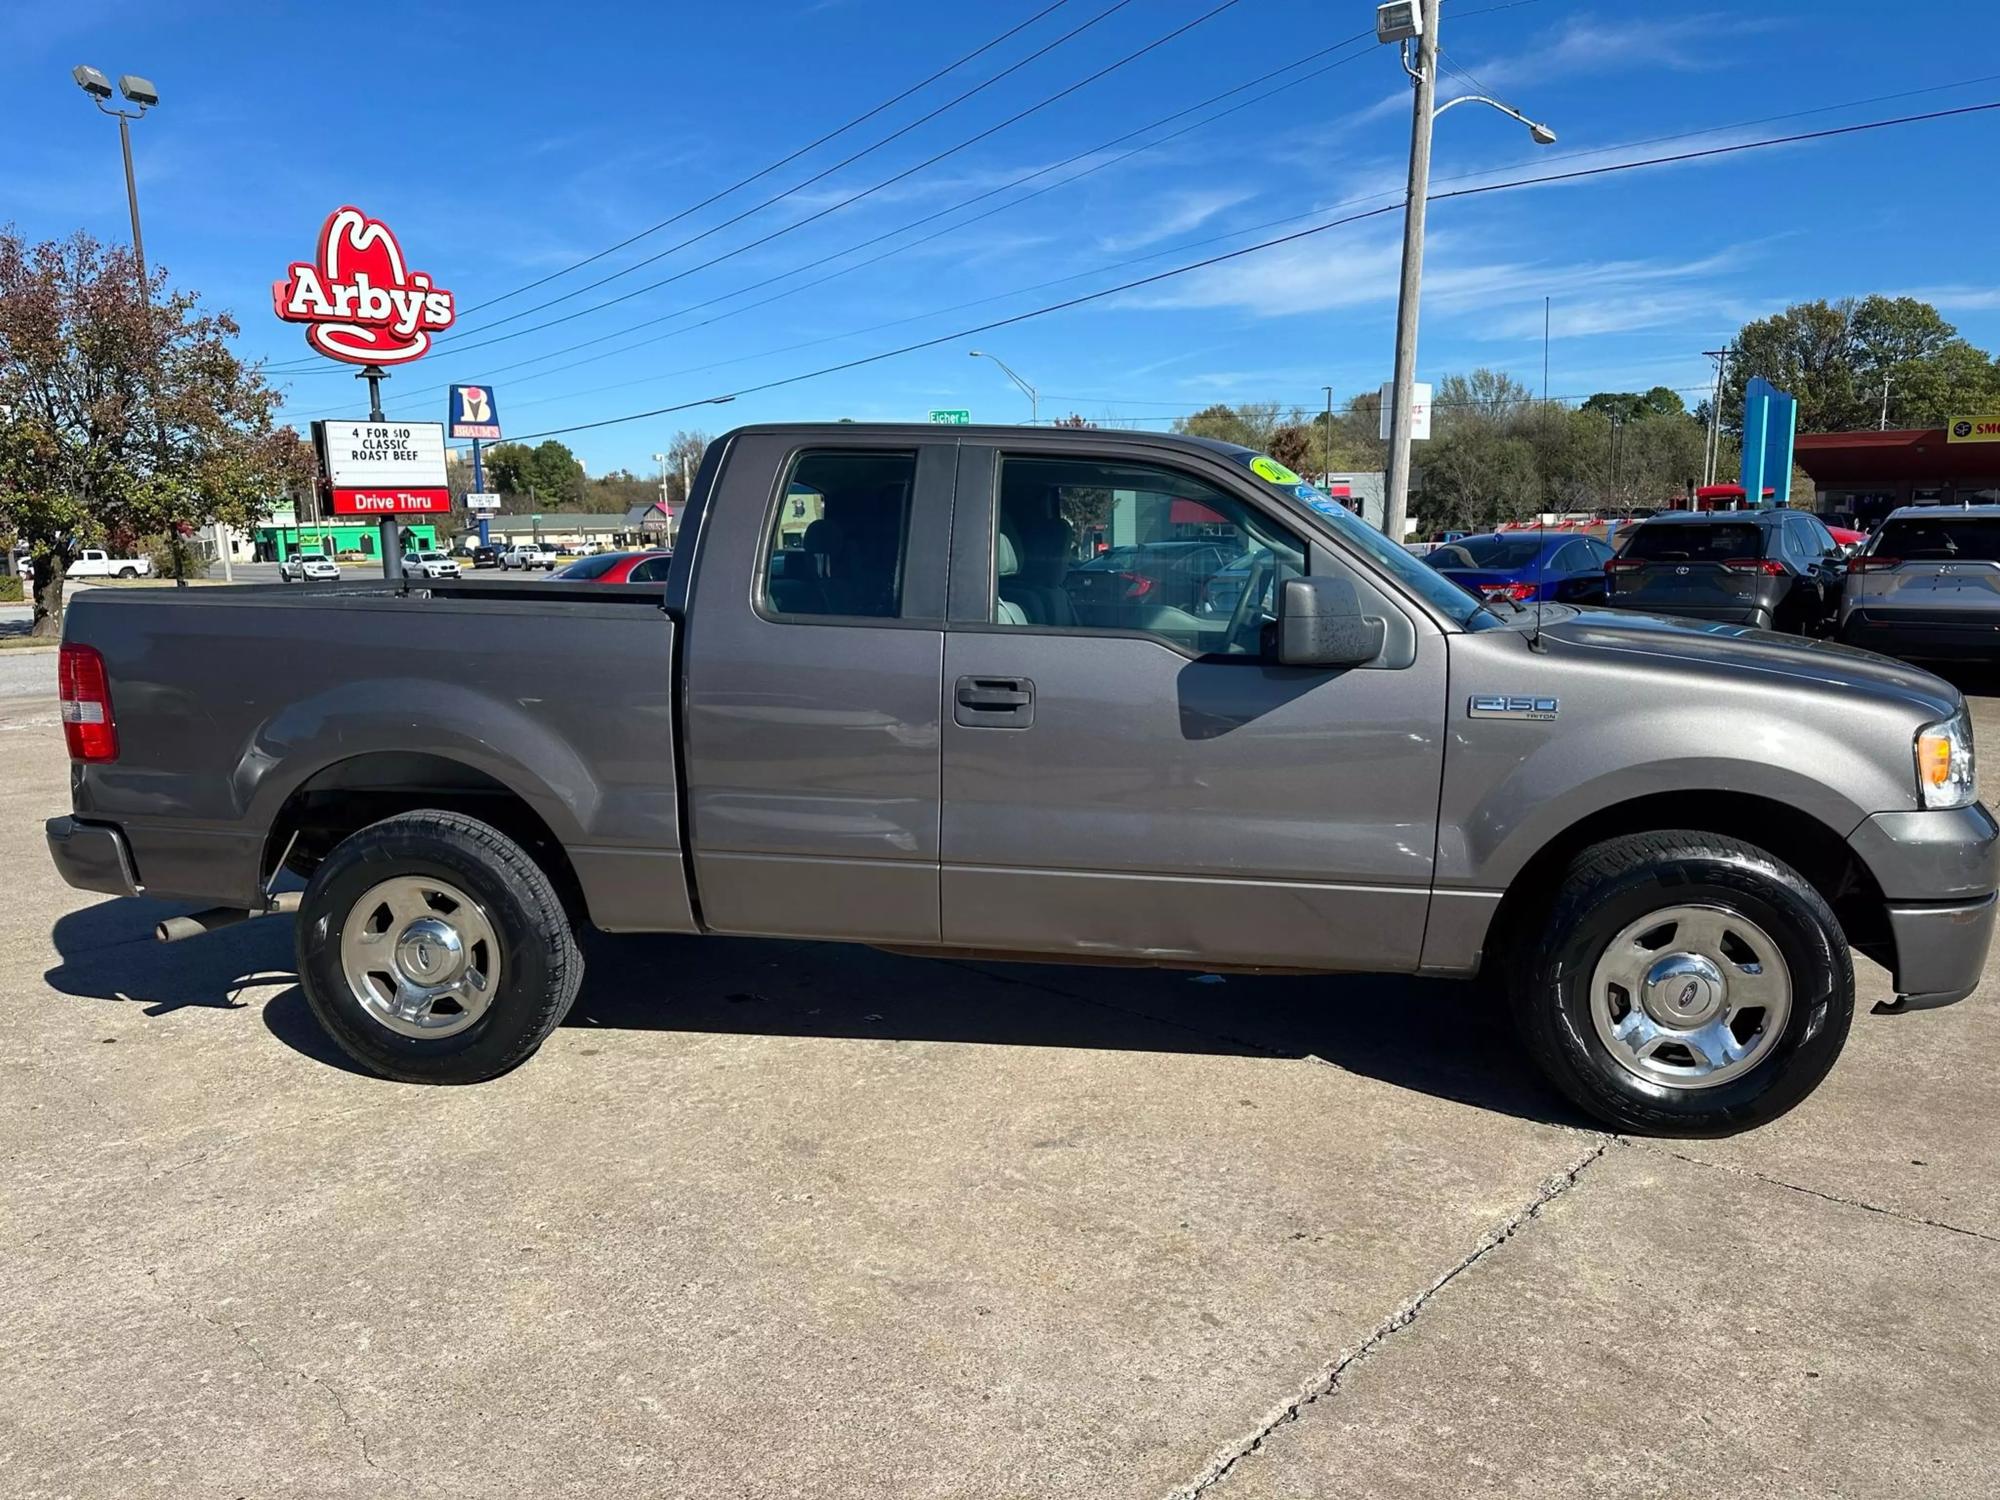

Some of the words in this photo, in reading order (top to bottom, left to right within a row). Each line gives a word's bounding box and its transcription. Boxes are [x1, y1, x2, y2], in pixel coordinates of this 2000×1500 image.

[288, 266, 452, 335] Arby's
[930, 412, 960, 424] Eicher
[352, 428, 359, 438] 4
[367, 428, 388, 438] FOR
[393, 428, 411, 439] $10
[362, 439, 408, 450] CLASSIC
[352, 450, 388, 460] ROAST
[393, 451, 418, 461] BEEF
[355, 493, 394, 510] Drive
[397, 493, 432, 509] Thru
